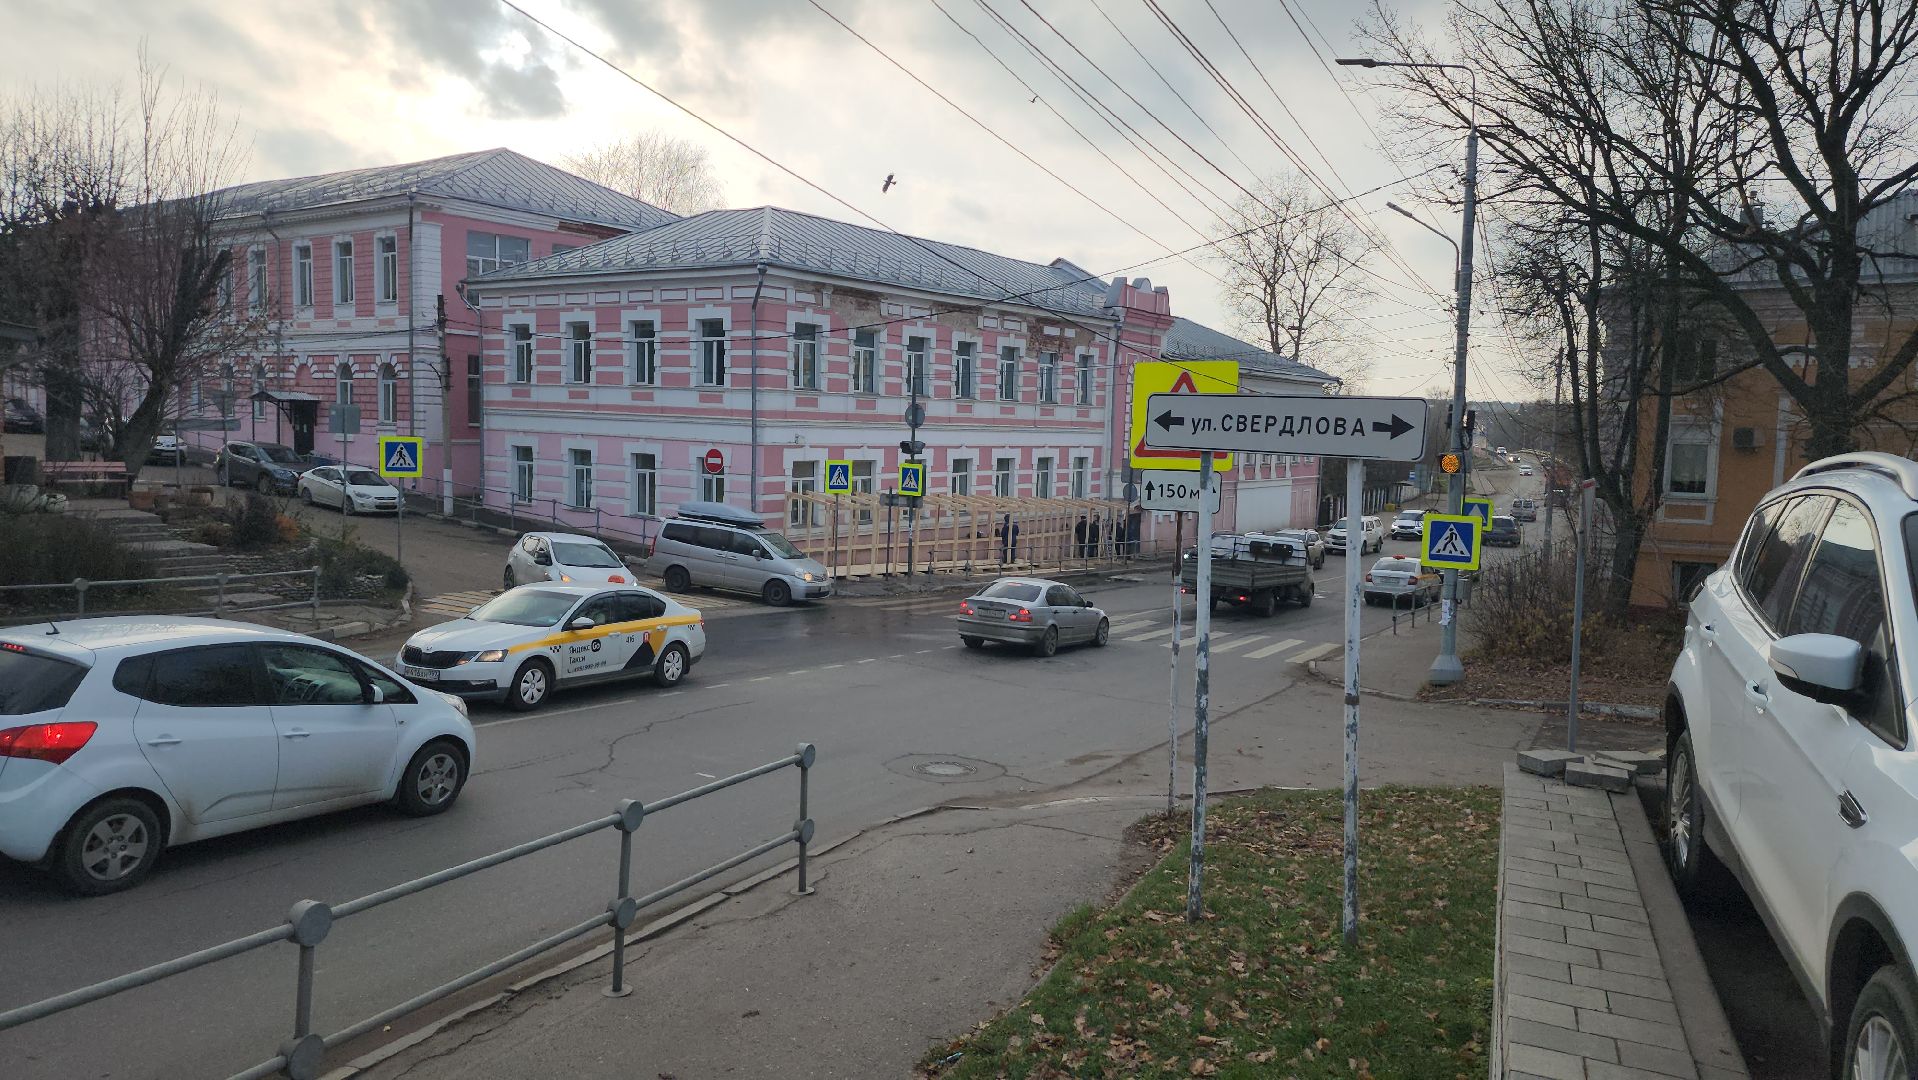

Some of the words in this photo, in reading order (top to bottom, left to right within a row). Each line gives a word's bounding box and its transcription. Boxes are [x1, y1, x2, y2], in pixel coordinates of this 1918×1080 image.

[1191, 416, 1217, 435] ул.
[1220, 413, 1367, 437] СВЕРДЛОВА
[1158, 483, 1187, 499] 150
[568, 644, 591, 654] Яндекс
[569, 655, 586, 665] Такси
